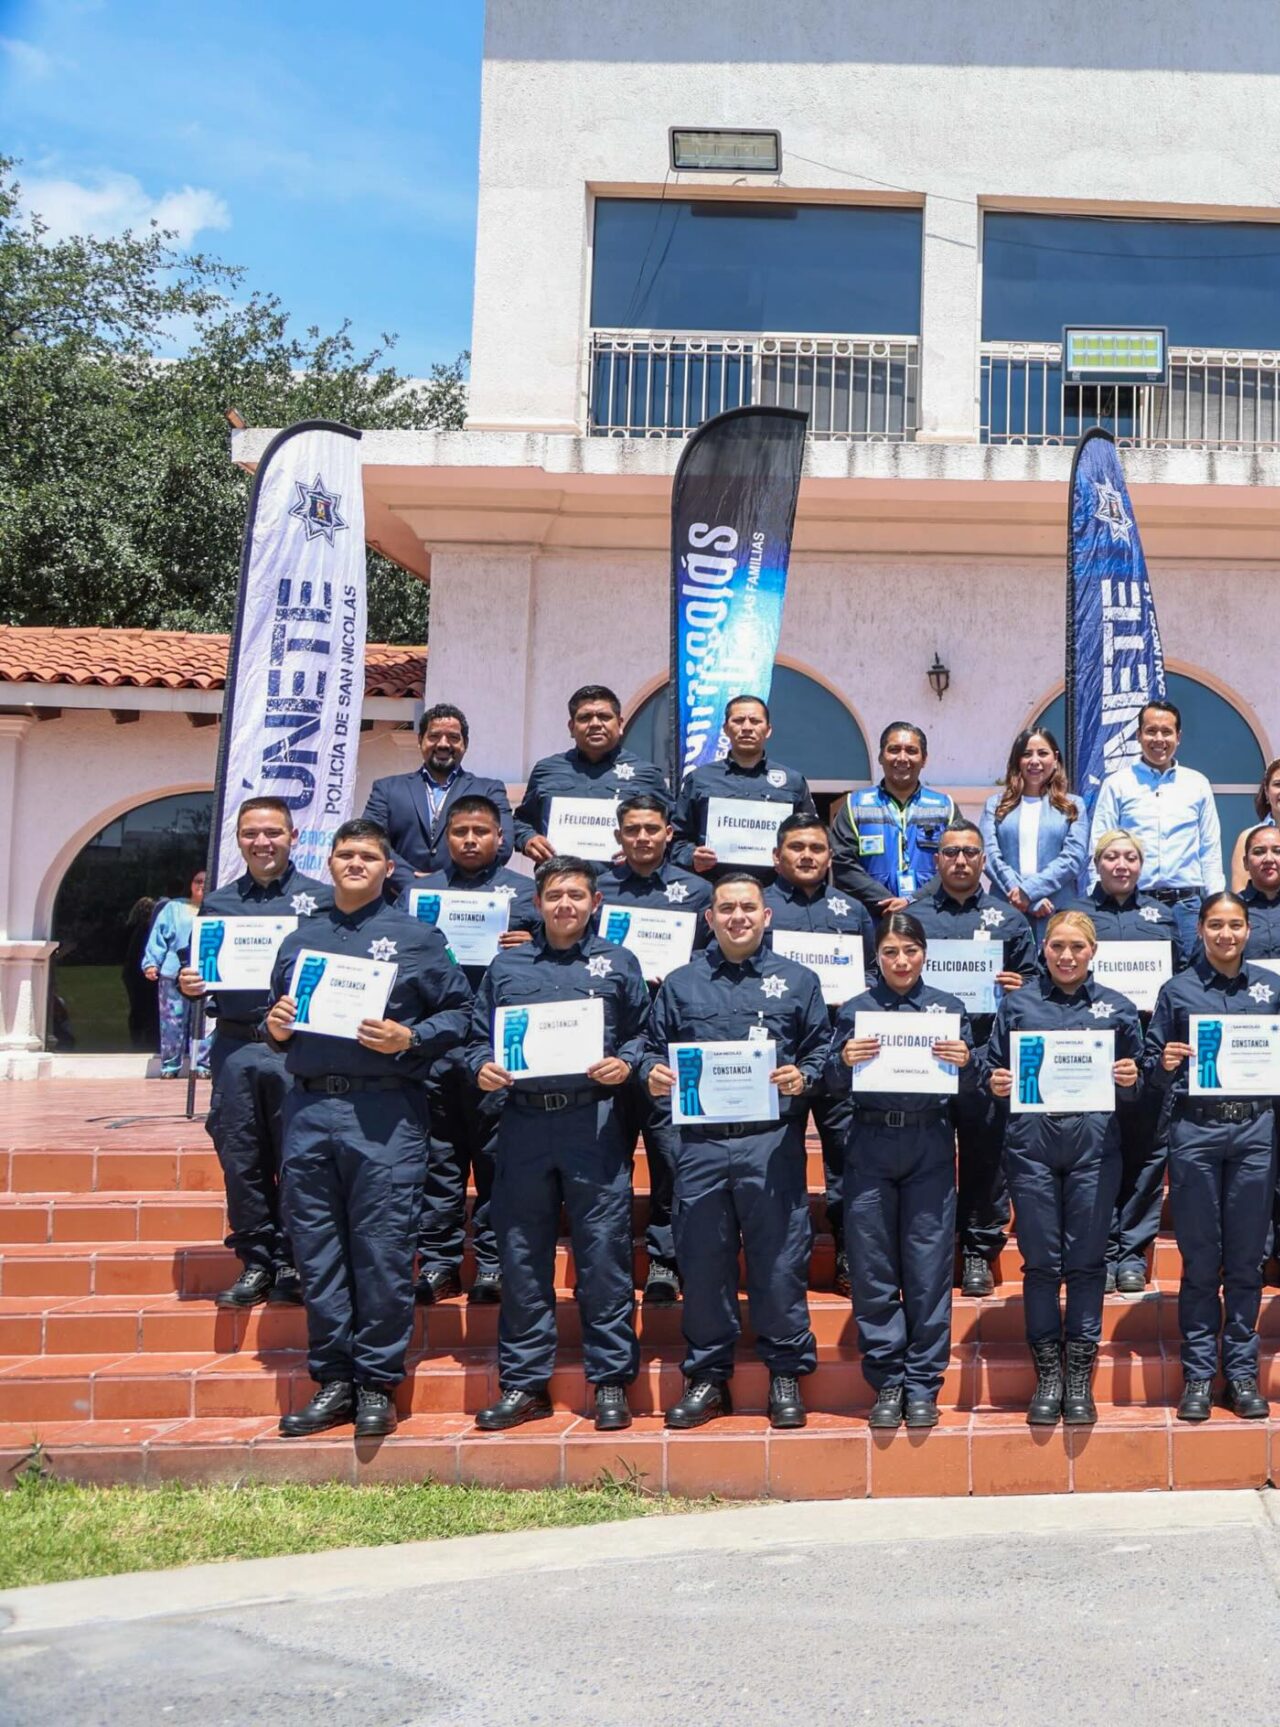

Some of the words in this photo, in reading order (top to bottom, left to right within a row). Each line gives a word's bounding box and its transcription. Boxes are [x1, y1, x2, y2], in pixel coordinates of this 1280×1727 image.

[744, 531, 765, 593] FAMILIAS
[339, 585, 358, 665] NICOLÁS
[243, 578, 332, 812] ÚNETE
[337, 668, 355, 708] SAN
[334, 711, 351, 738] DE
[324, 742, 348, 816] POLICÍA
[449, 912, 486, 922] CONSTANCIA
[234, 937, 273, 946] CONSTANCIA
[638, 930, 672, 941] CONSTANCIA
[1231, 1039, 1269, 1049] CONSTANCIA
[1053, 1055, 1092, 1064] CONSTANCIA
[713, 1065, 752, 1076] CONSTANCIA
